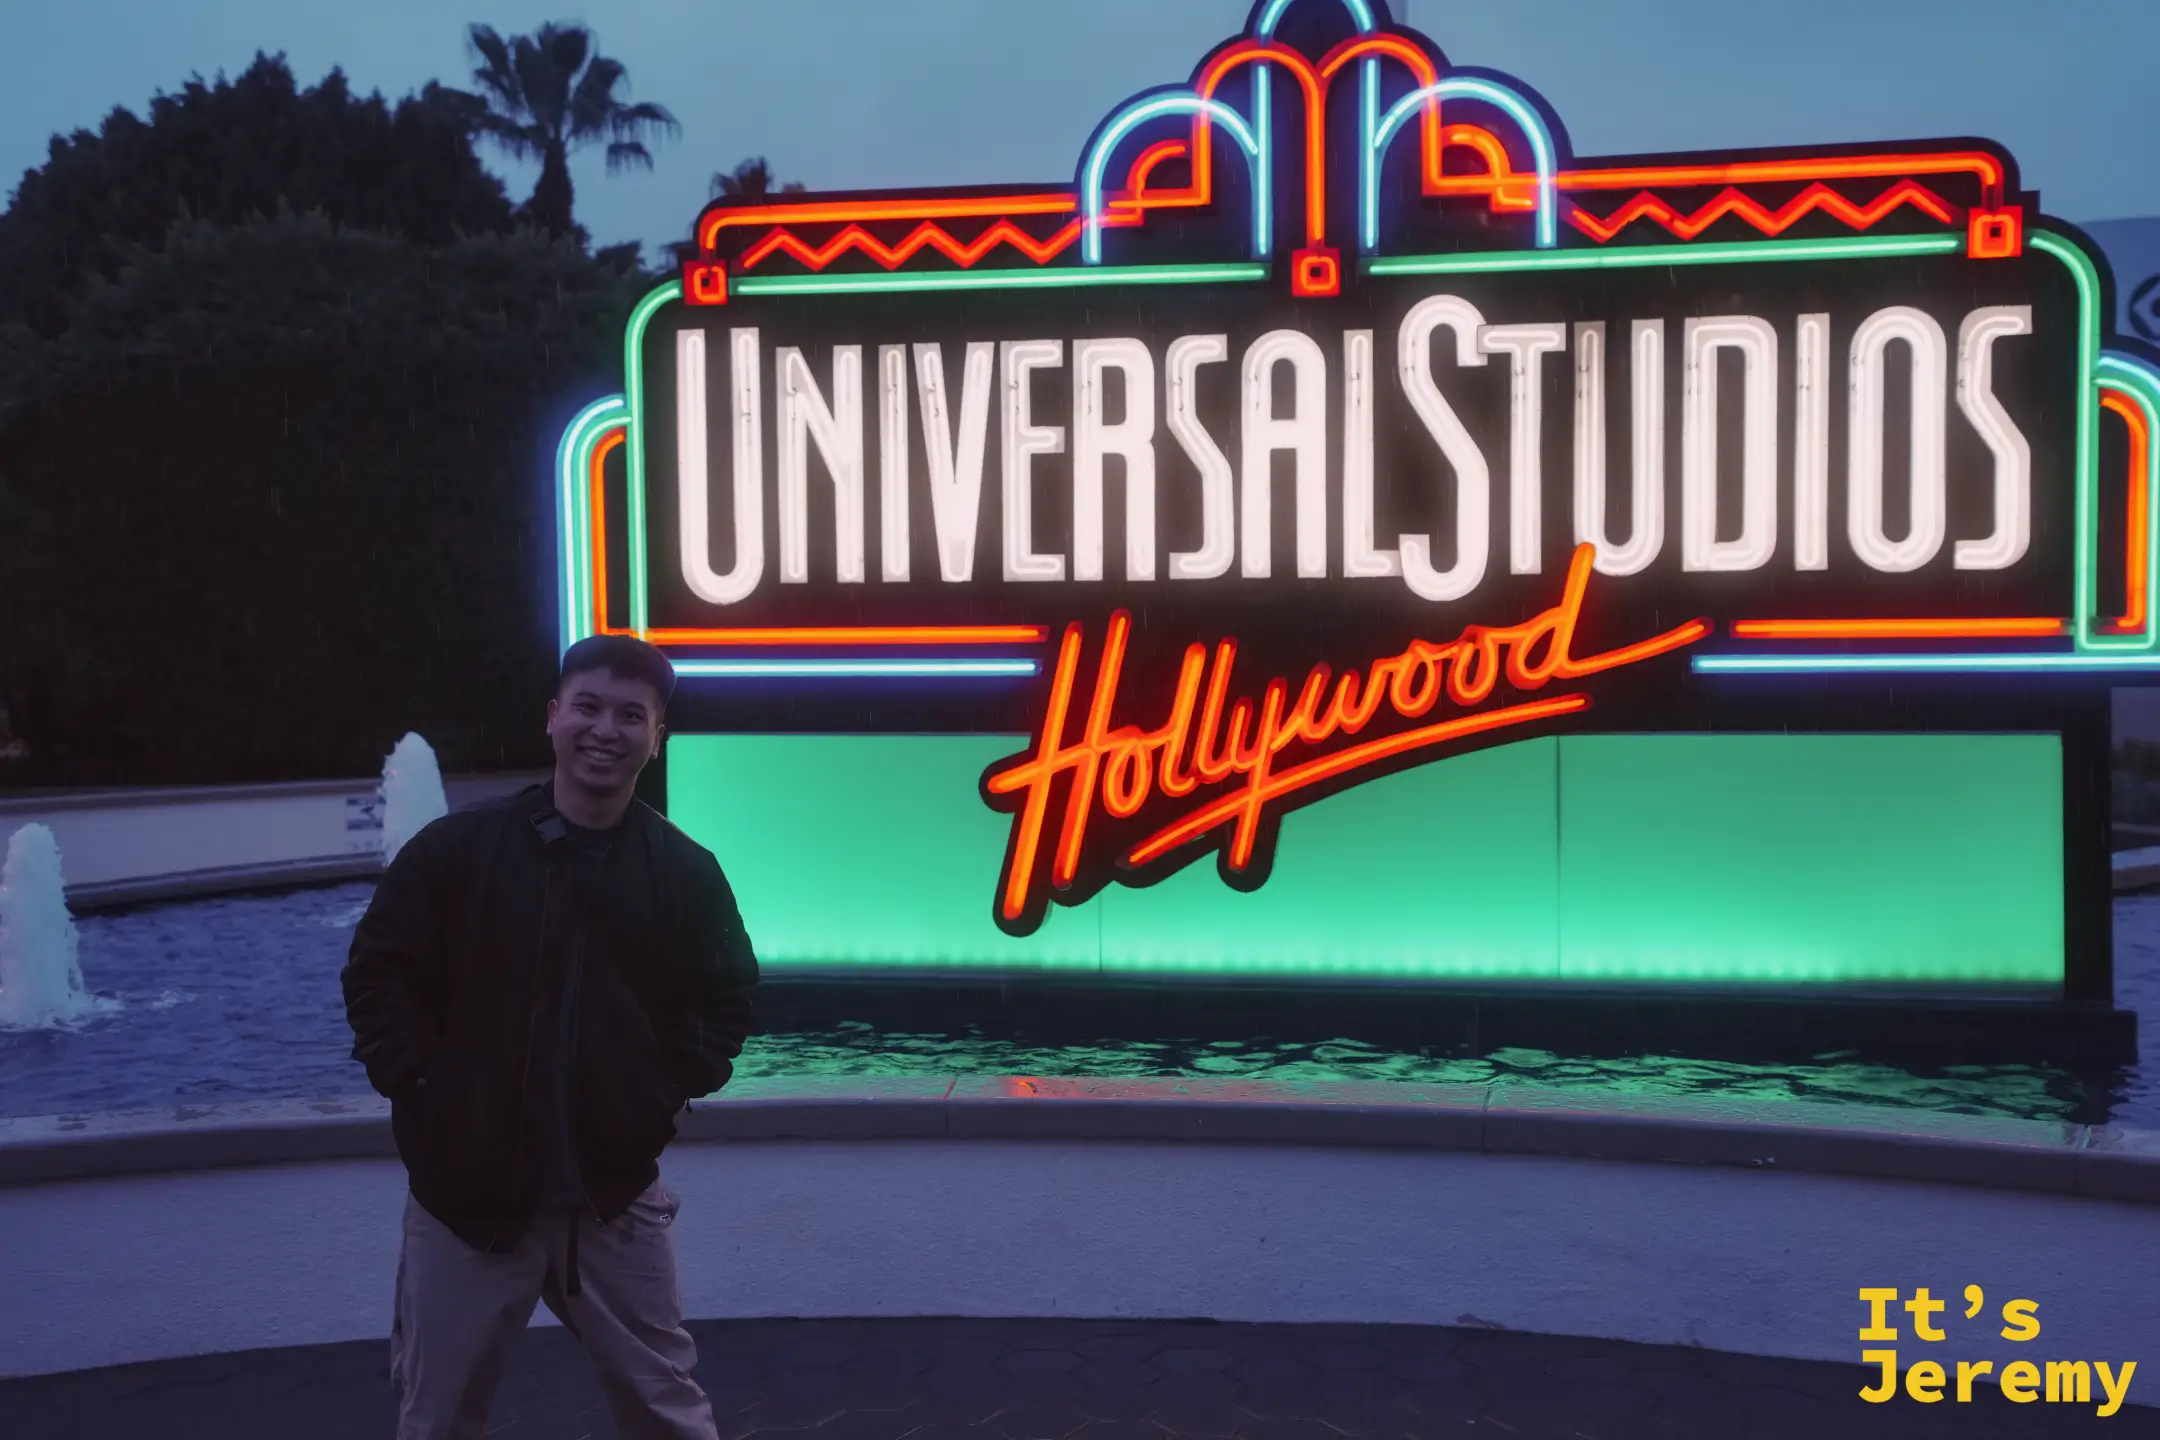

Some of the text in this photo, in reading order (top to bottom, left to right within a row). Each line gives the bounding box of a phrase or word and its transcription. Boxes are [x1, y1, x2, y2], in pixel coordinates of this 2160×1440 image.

[676, 293, 2034, 605] UNIVERSAL STUDIOS
[986, 541, 1714, 924] Hollywood
